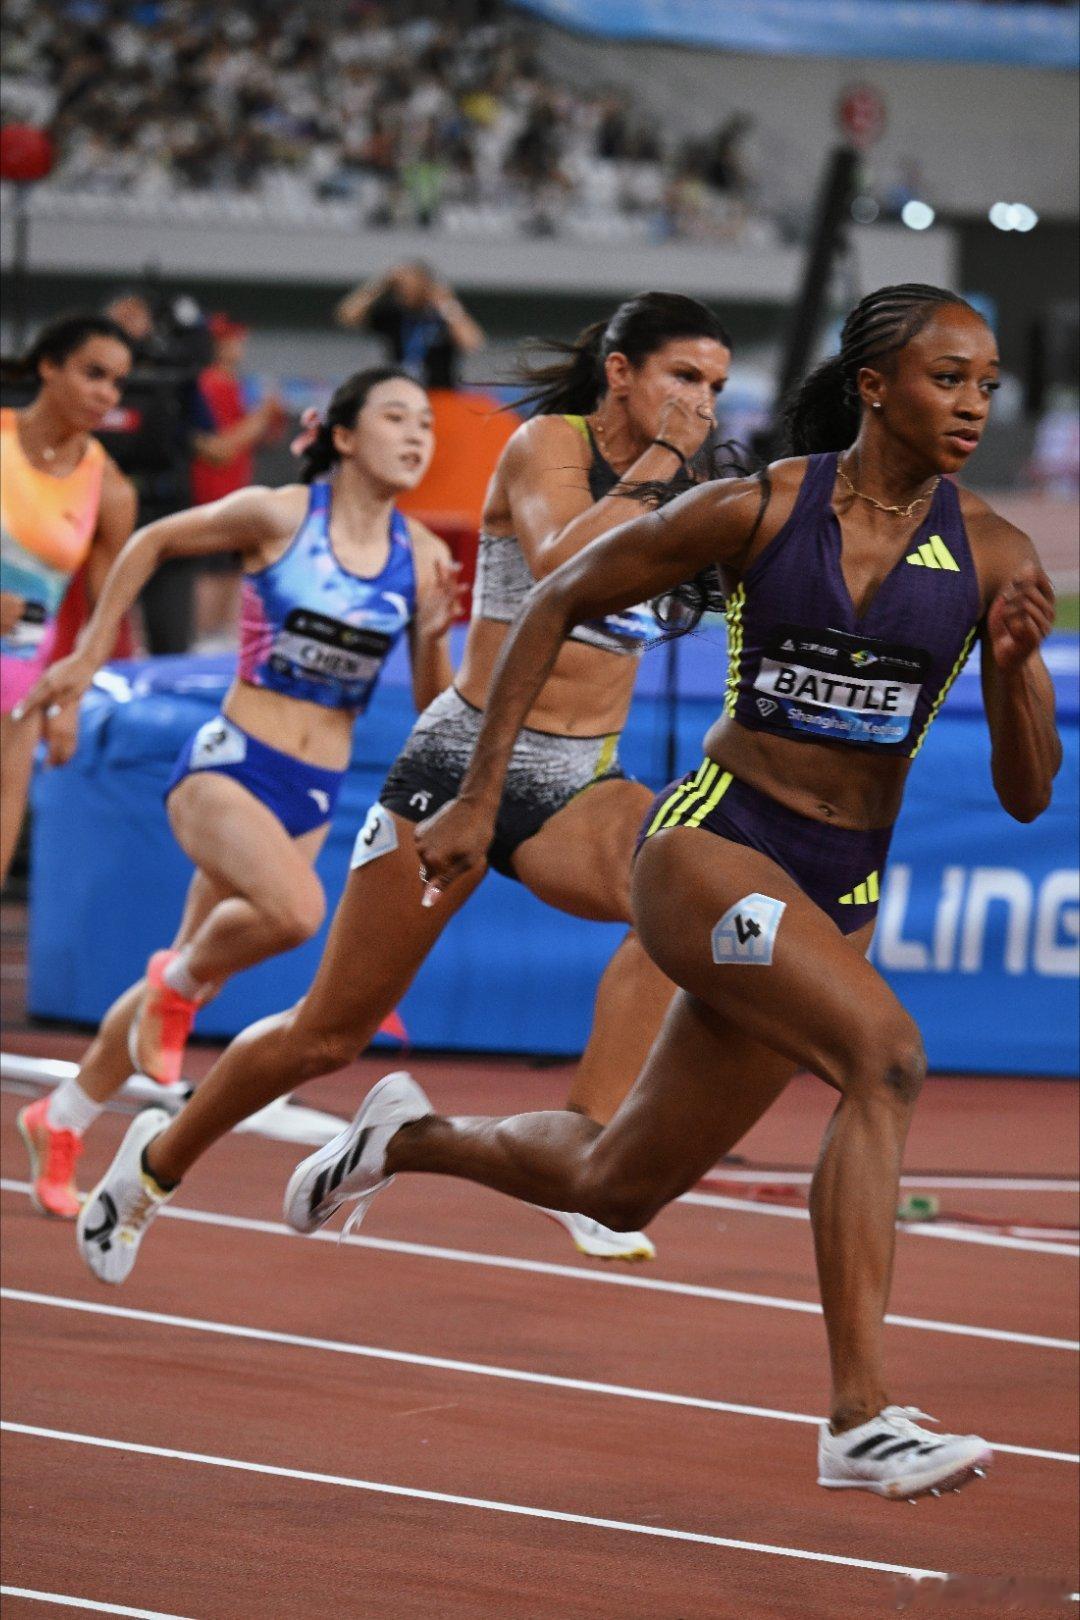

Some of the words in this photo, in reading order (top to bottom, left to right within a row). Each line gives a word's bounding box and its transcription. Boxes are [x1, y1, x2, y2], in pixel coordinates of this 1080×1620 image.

[773, 667, 902, 712] BATTLE
[787, 707, 853, 731] Shanghai
[734, 914, 762, 945] 4
